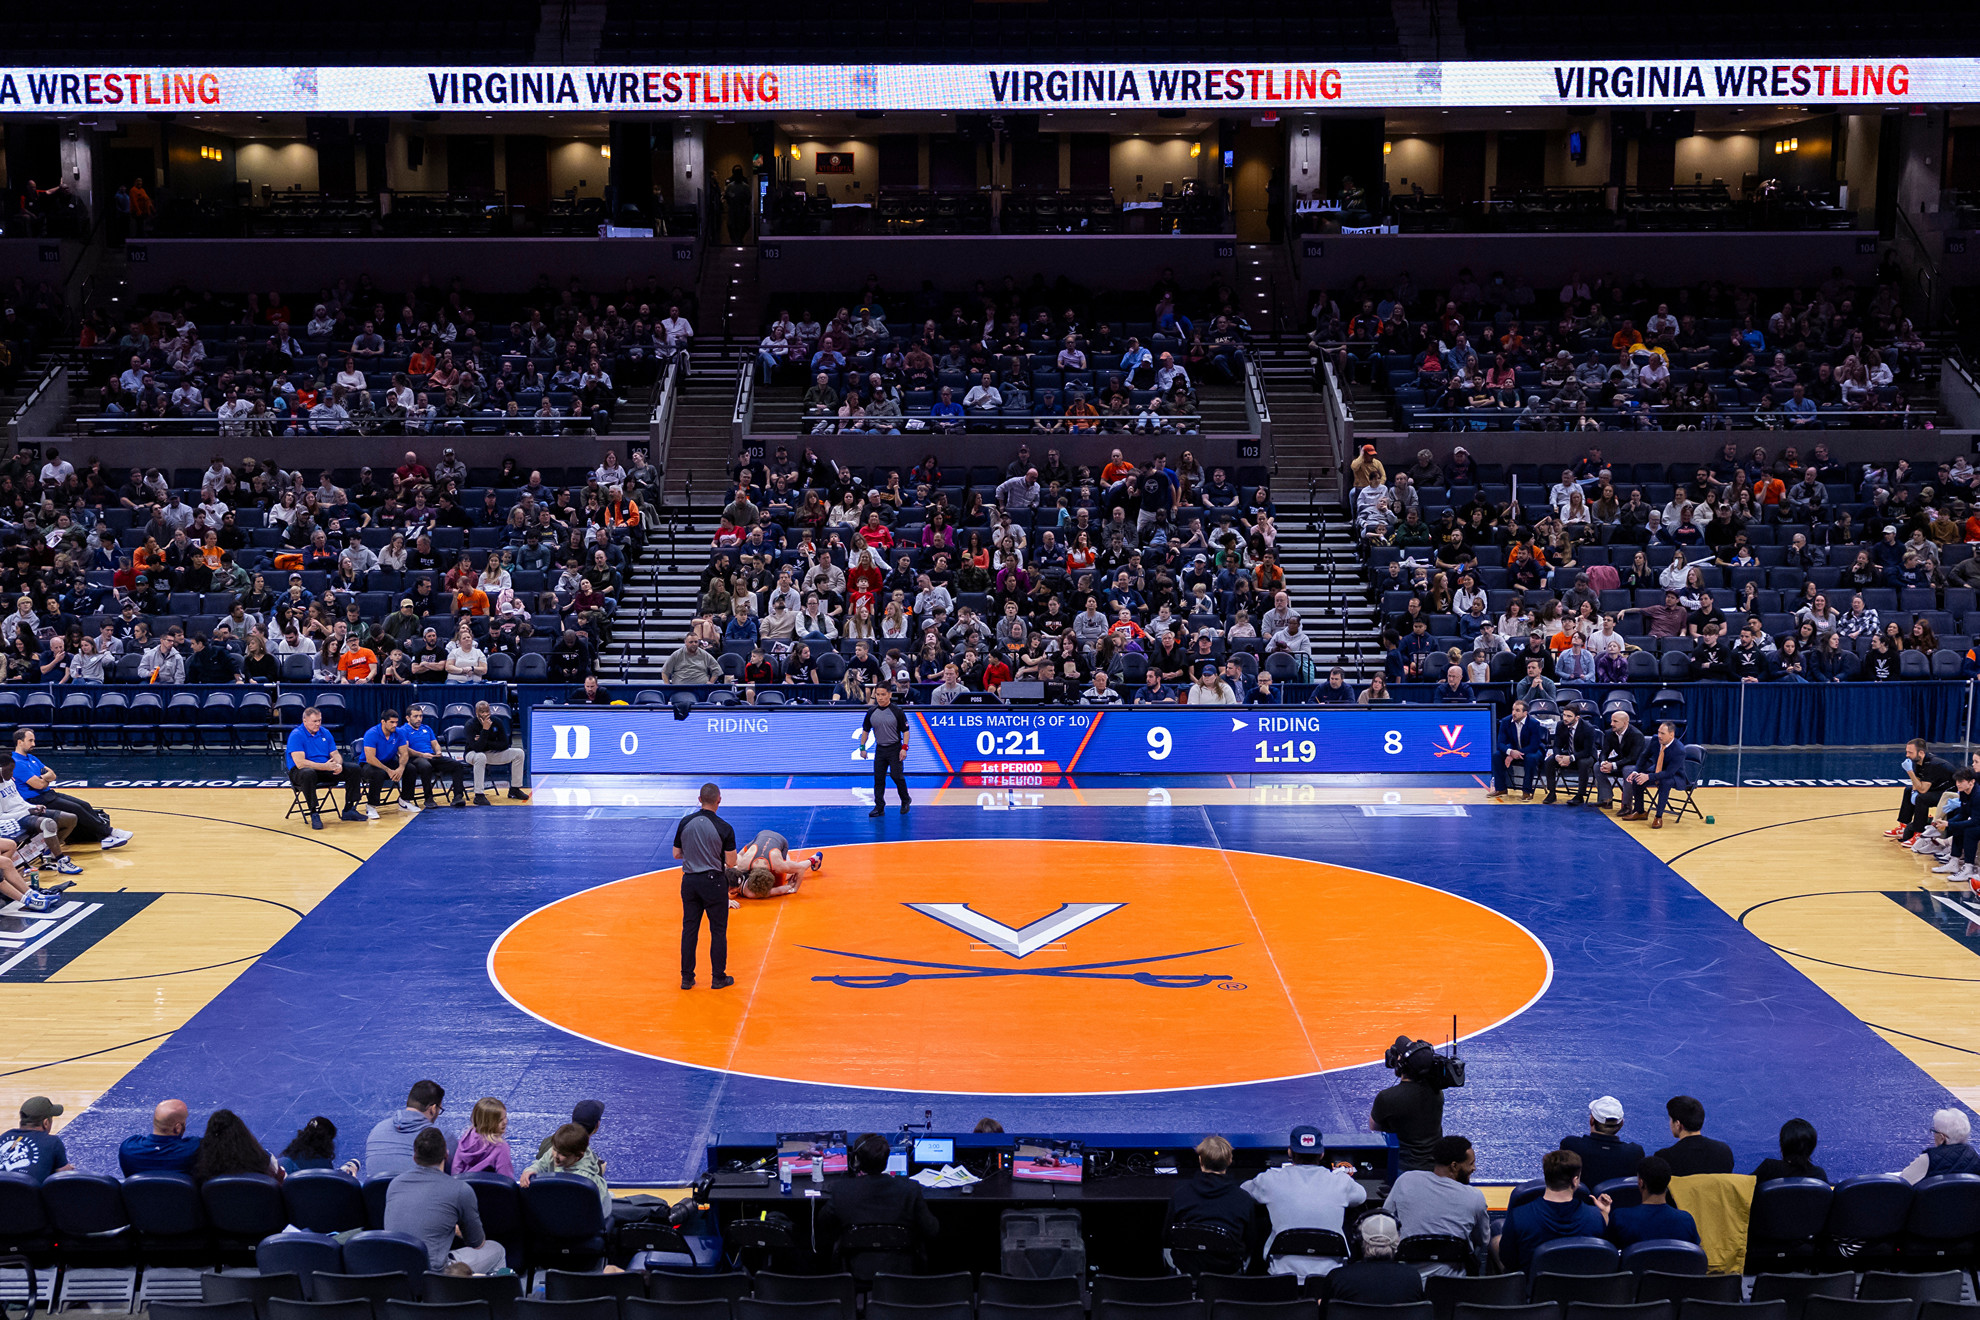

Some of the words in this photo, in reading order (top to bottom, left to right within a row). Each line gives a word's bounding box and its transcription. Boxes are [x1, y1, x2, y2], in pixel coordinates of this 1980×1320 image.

[27, 73, 220, 105] WRESTLING
[428, 73, 578, 104] VIRGINIA
[585, 72, 779, 104] WRESTLING
[989, 70, 1140, 102] VIRGINIA
[1147, 69, 1342, 101] WRESTLING
[1554, 66, 1705, 99] VIRGINIA
[1714, 64, 1910, 97] WRESTLING
[44, 252, 59, 260] 101
[131, 252, 146, 260] 102
[677, 250, 691, 259] 102
[765, 249, 779, 258] 103
[1218, 248, 1233, 257] 103
[1307, 247, 1322, 257] 104
[1860, 244, 1875, 253] 104
[1242, 446, 1258, 457] 103
[707, 717, 769, 733] RIDING
[932, 716, 956, 727] 141
[960, 716, 983, 727] LBS
[987, 716, 1029, 727] MATCH
[1033, 715, 1046, 728] (3
[1049, 716, 1066, 727] OF
[1069, 715, 1090, 728] 10)
[1258, 717, 1320, 732] RIDING
[620, 732, 639, 755] 0
[976, 731, 1044, 755] 0:21
[1147, 727, 1172, 760] 9
[1384, 731, 1403, 755] 8
[1254, 740, 1317, 763] 1:19
[981, 763, 998, 772] 1st
[1001, 763, 1042, 772] PERIOD
